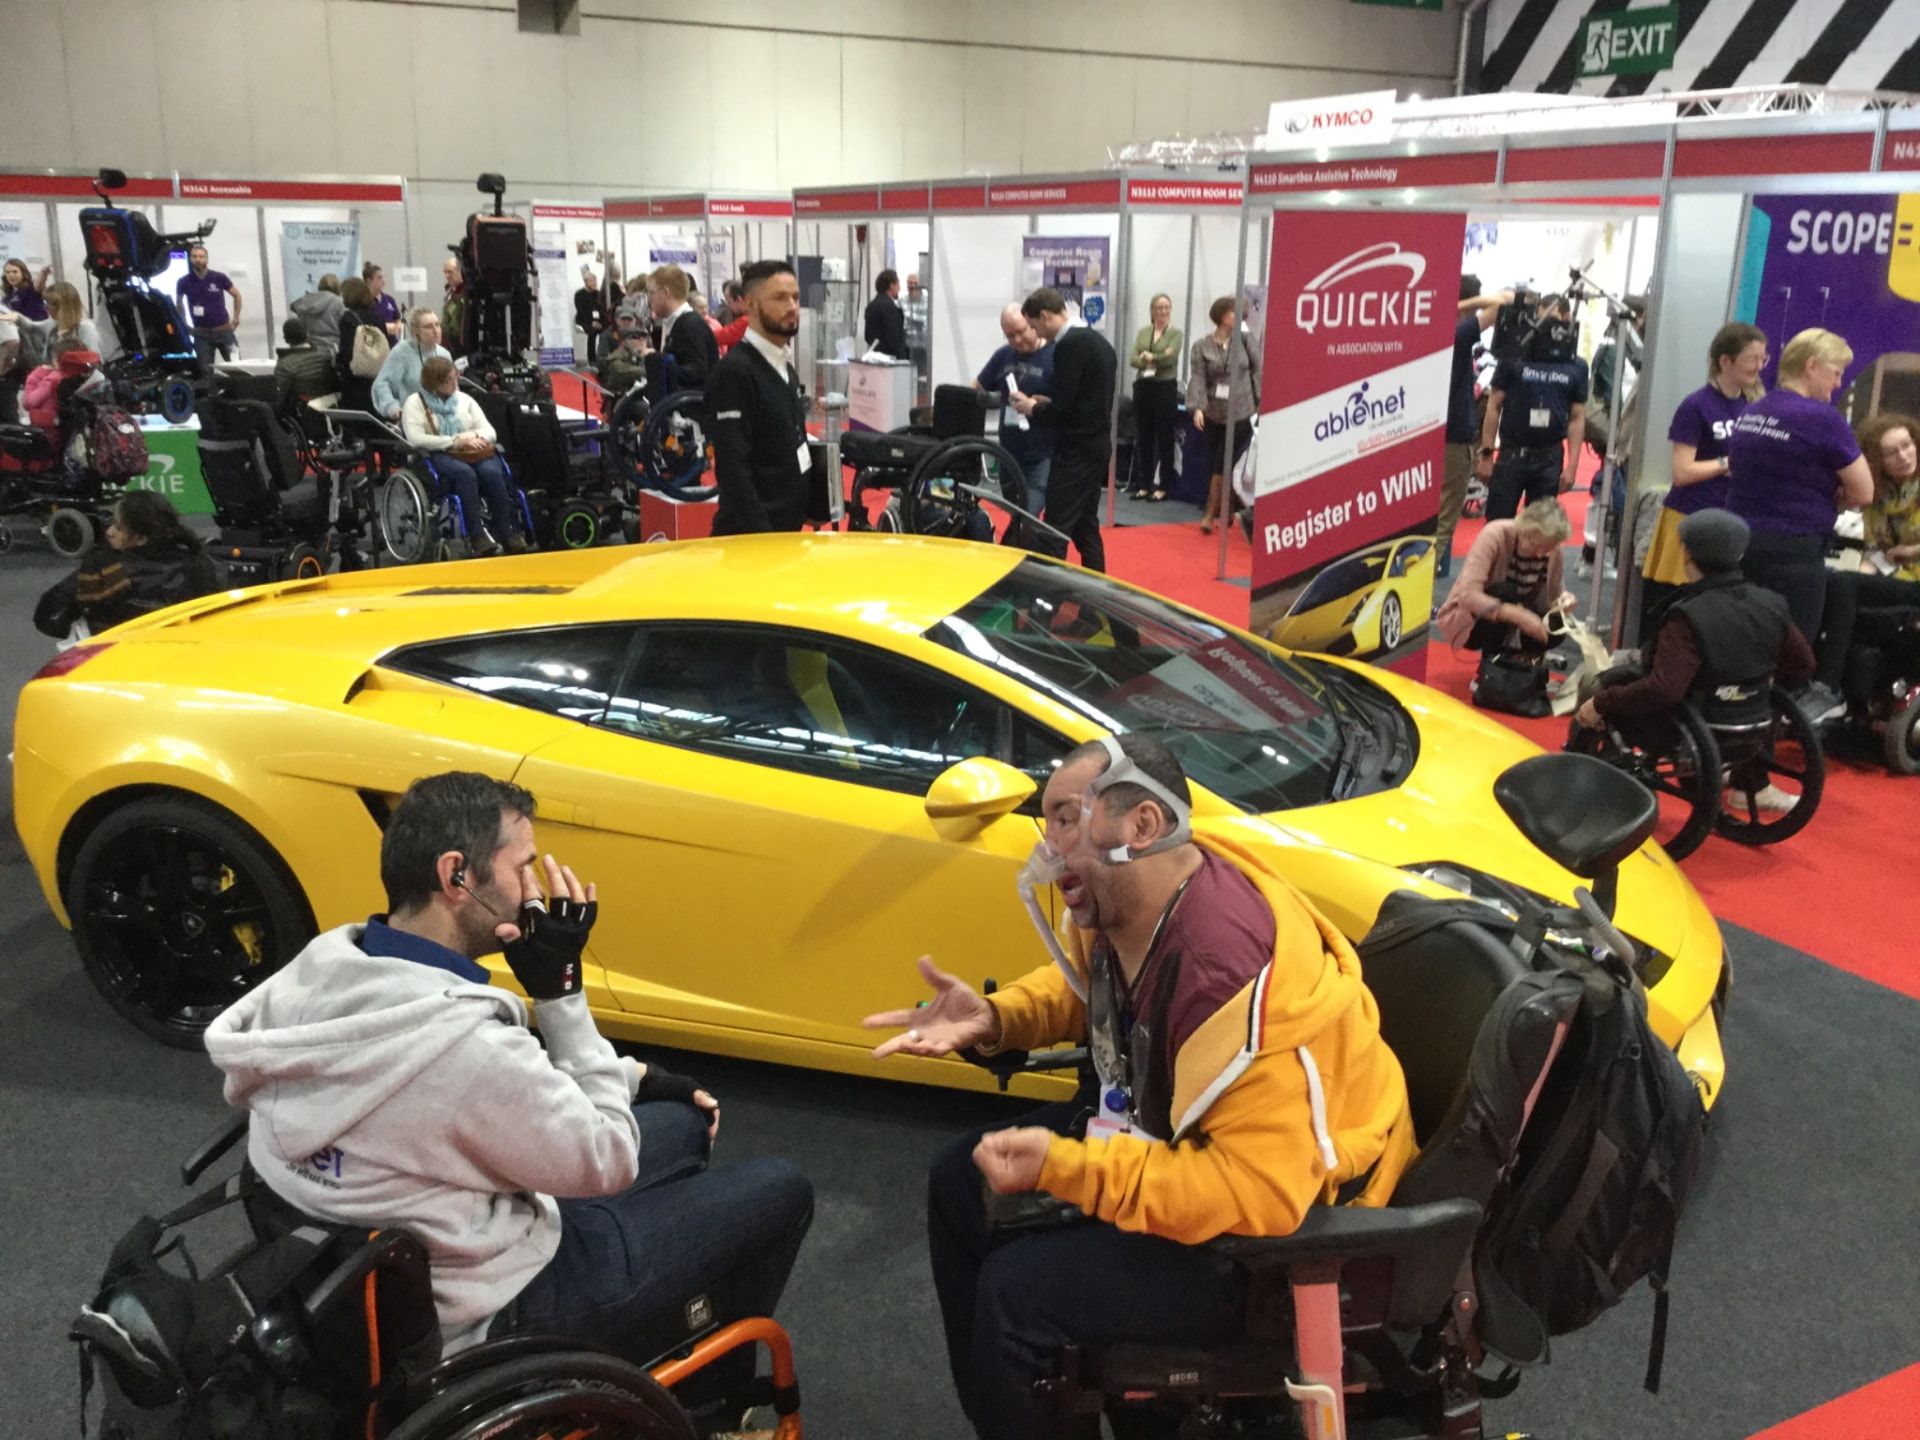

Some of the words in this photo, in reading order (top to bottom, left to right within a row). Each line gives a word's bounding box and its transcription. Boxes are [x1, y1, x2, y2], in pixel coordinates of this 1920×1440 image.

[1611, 22, 1672, 59] EXIT
[1312, 108, 1374, 129] KYMCO
[1278, 171, 1313, 185] Smartbox
[1314, 169, 1349, 183] Assistive
[1351, 166, 1398, 182] Technology
[1158, 187, 1201, 199] COMPUTER
[1203, 188, 1226, 200] ROOM
[1786, 209, 1893, 255] SCOPE
[1029, 247, 1073, 259] Computer
[1076, 247, 1102, 258] Room
[1045, 257, 1086, 268] Services
[1296, 290, 1433, 335] QUICKIE
[1327, 344, 1335, 356] IN
[1336, 341, 1383, 355] ASSOCIATION
[1384, 340, 1403, 353] WITH
[1314, 386, 1406, 442] ablenet
[1264, 499, 1353, 555] Register
[1356, 490, 1378, 517] to
[1381, 460, 1433, 506] WIN!
